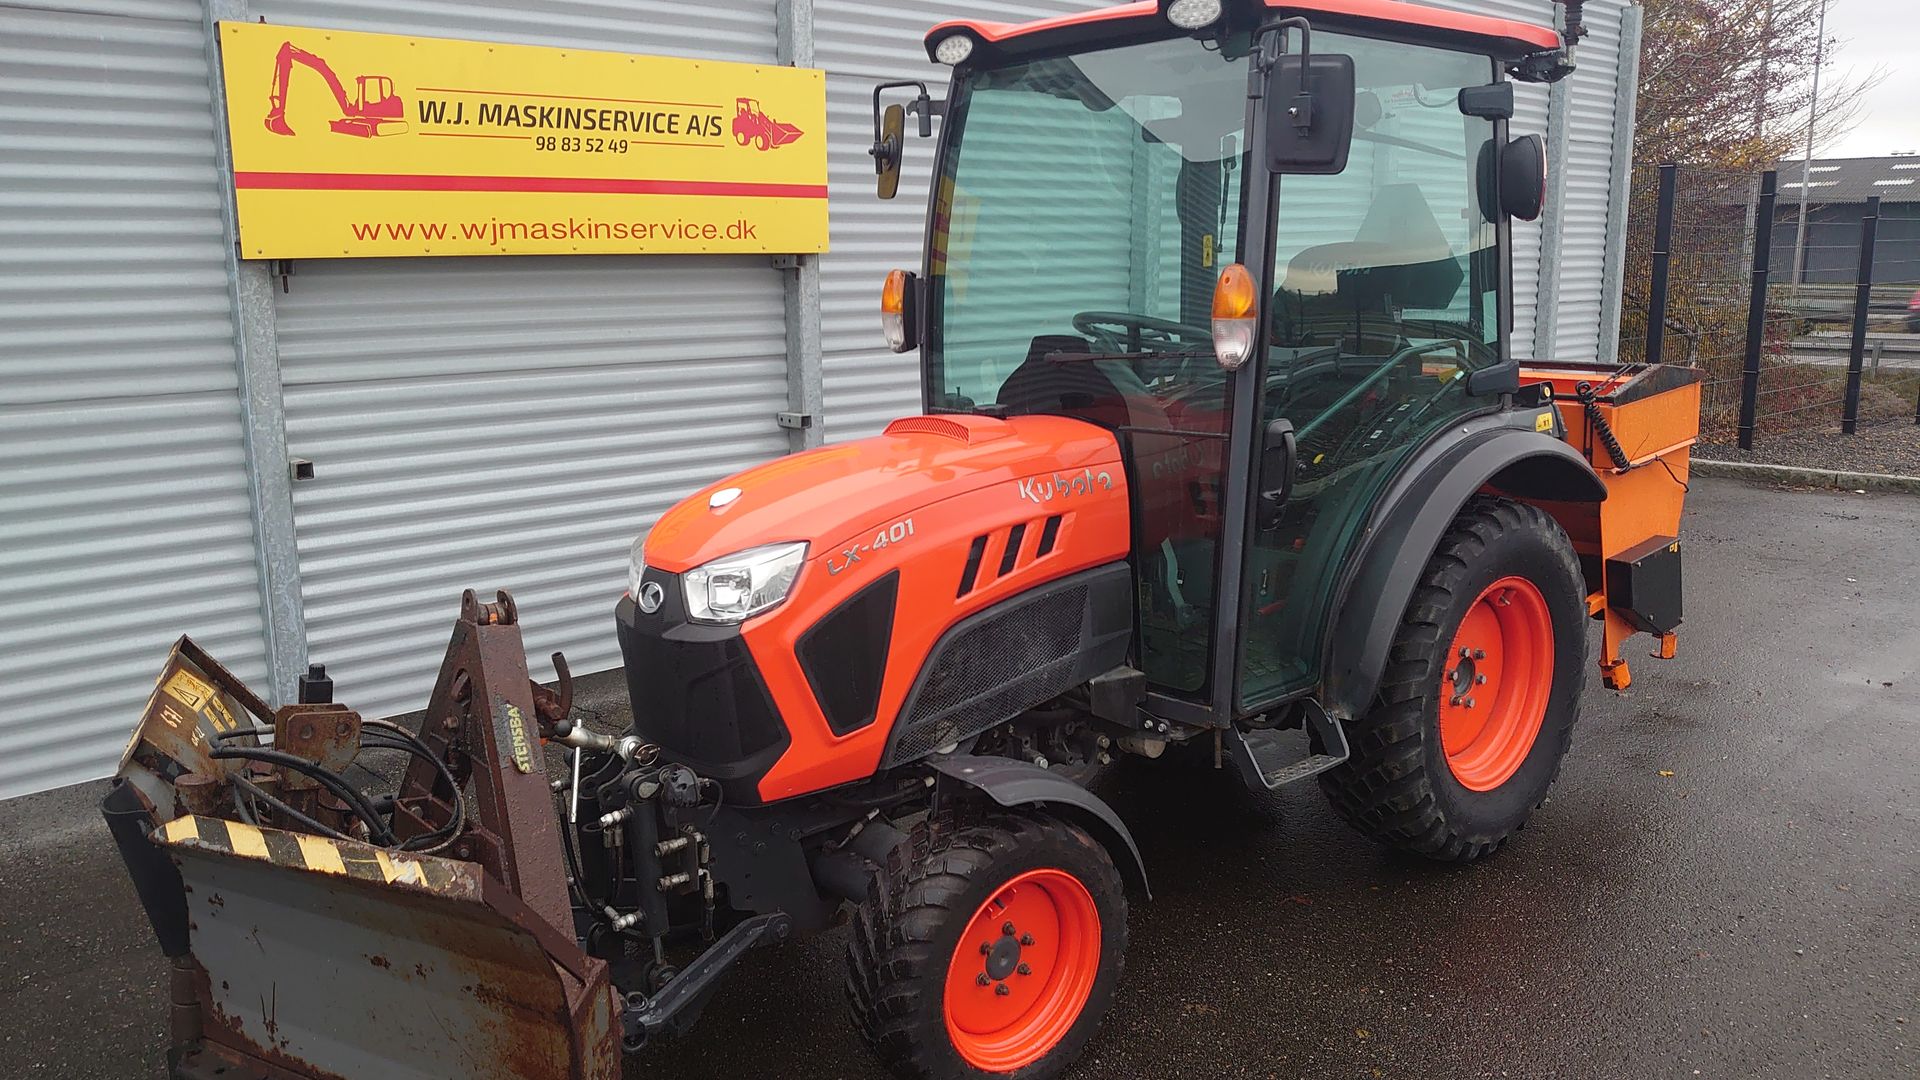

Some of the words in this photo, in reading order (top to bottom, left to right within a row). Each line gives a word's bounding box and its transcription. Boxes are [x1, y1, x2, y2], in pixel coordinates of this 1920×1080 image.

[419, 100, 470, 126] W.J.
[478, 103, 680, 135] MASKINSERVICE
[686, 113, 723, 137] A/S
[535, 136, 556, 151] 98
[561, 137, 581, 152] 83
[585, 138, 604, 153] 52
[608, 139, 628, 154] 49
[351, 217, 758, 246] www.wjmaskinservice.dk
[1018, 468, 1113, 503] Kubota
[826, 517, 915, 576] LX-401
